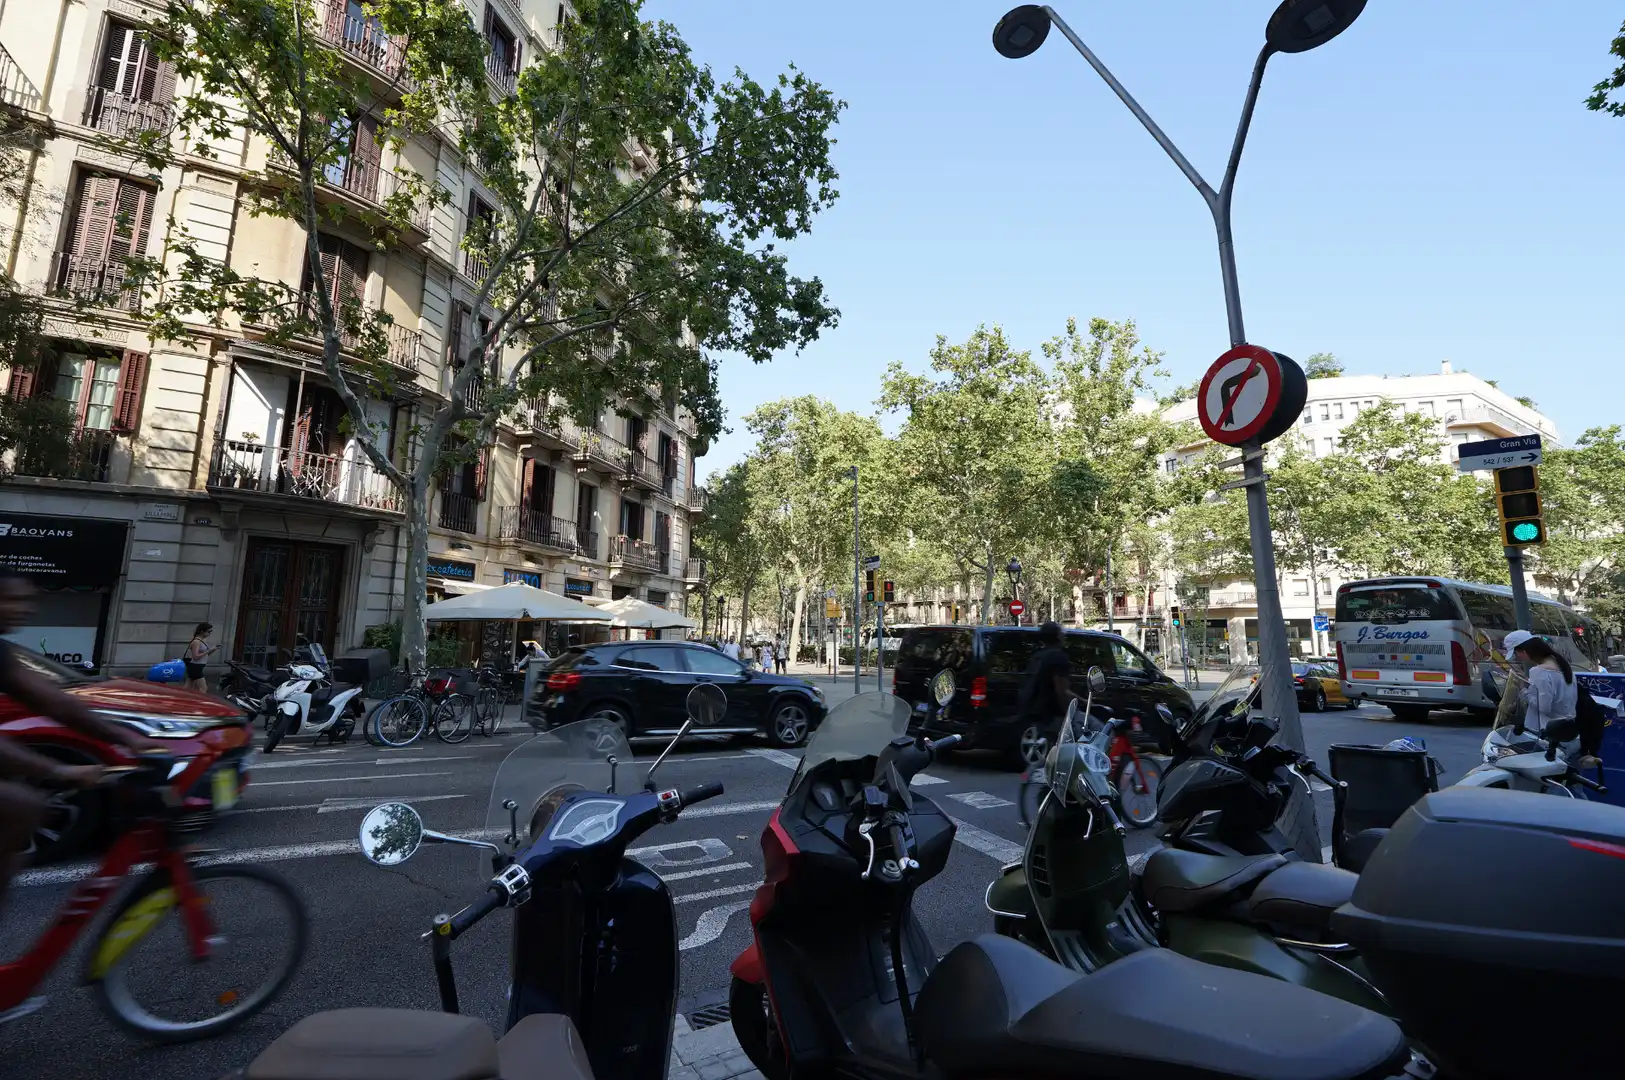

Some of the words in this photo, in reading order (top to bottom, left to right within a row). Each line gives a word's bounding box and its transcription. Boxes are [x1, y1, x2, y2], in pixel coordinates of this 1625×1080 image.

[1500, 440, 1520, 448] Gran
[1522, 438, 1537, 446] Via
[11, 527, 74, 538] BAOVANS
[17, 560, 56, 568] furgonetas
[1372, 626, 1430, 644] Burgos
